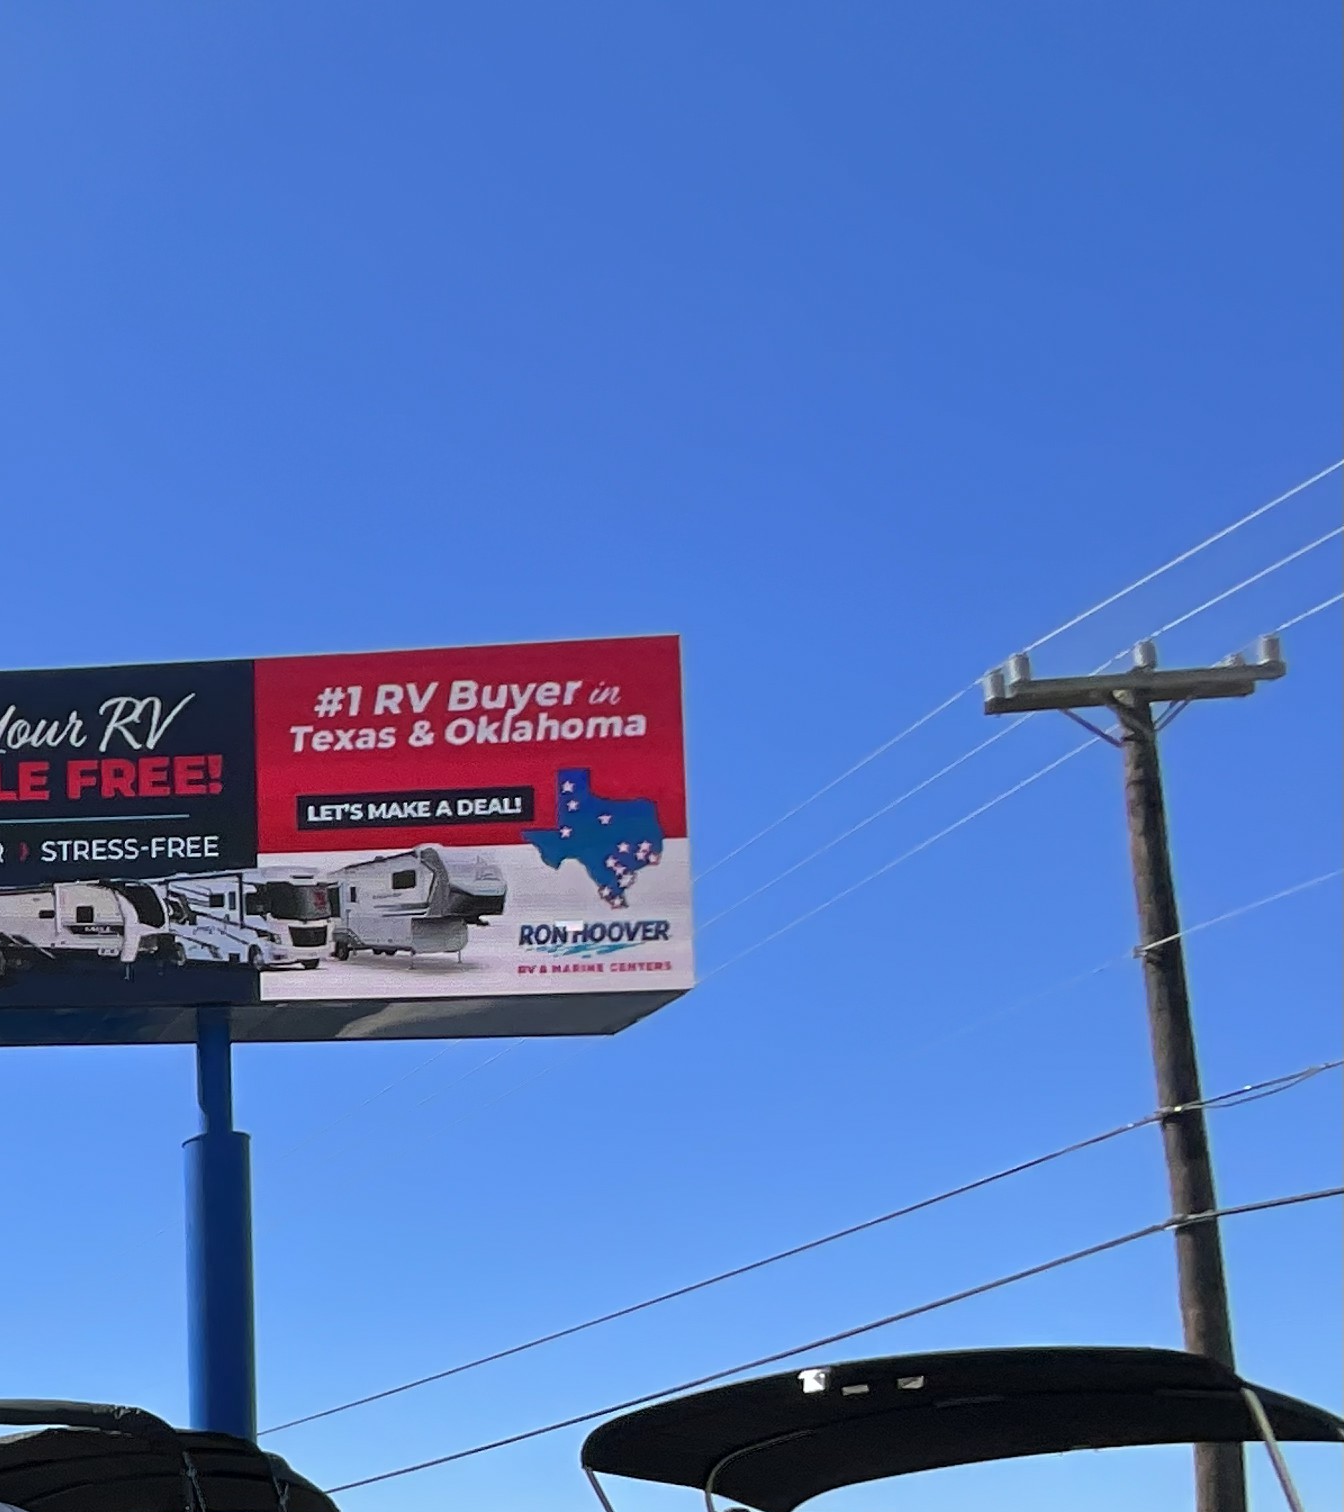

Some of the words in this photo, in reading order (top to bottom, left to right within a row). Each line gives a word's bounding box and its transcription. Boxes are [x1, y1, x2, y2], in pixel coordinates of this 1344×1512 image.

[314, 687, 362, 718] #1
[374, 682, 439, 716] RV
[447, 680, 584, 716] Buyer
[588, 681, 622, 706] in
[98, 693, 196, 753] RV
[289, 725, 396, 752] Texas
[408, 720, 434, 747] &
[444, 710, 647, 745] Oklahoma
[66, 754, 223, 800] FREE!
[307, 803, 363, 822] LET'S
[368, 801, 431, 819] MAKE
[436, 801, 451, 816] A
[455, 798, 521, 815] DEAL!
[40, 836, 220, 862] STRESS-FREE
[519, 924, 568, 945] RON
[571, 919, 670, 943] HOOVER
[552, 963, 604, 973] MARINE
[609, 961, 672, 972] CENTERS
